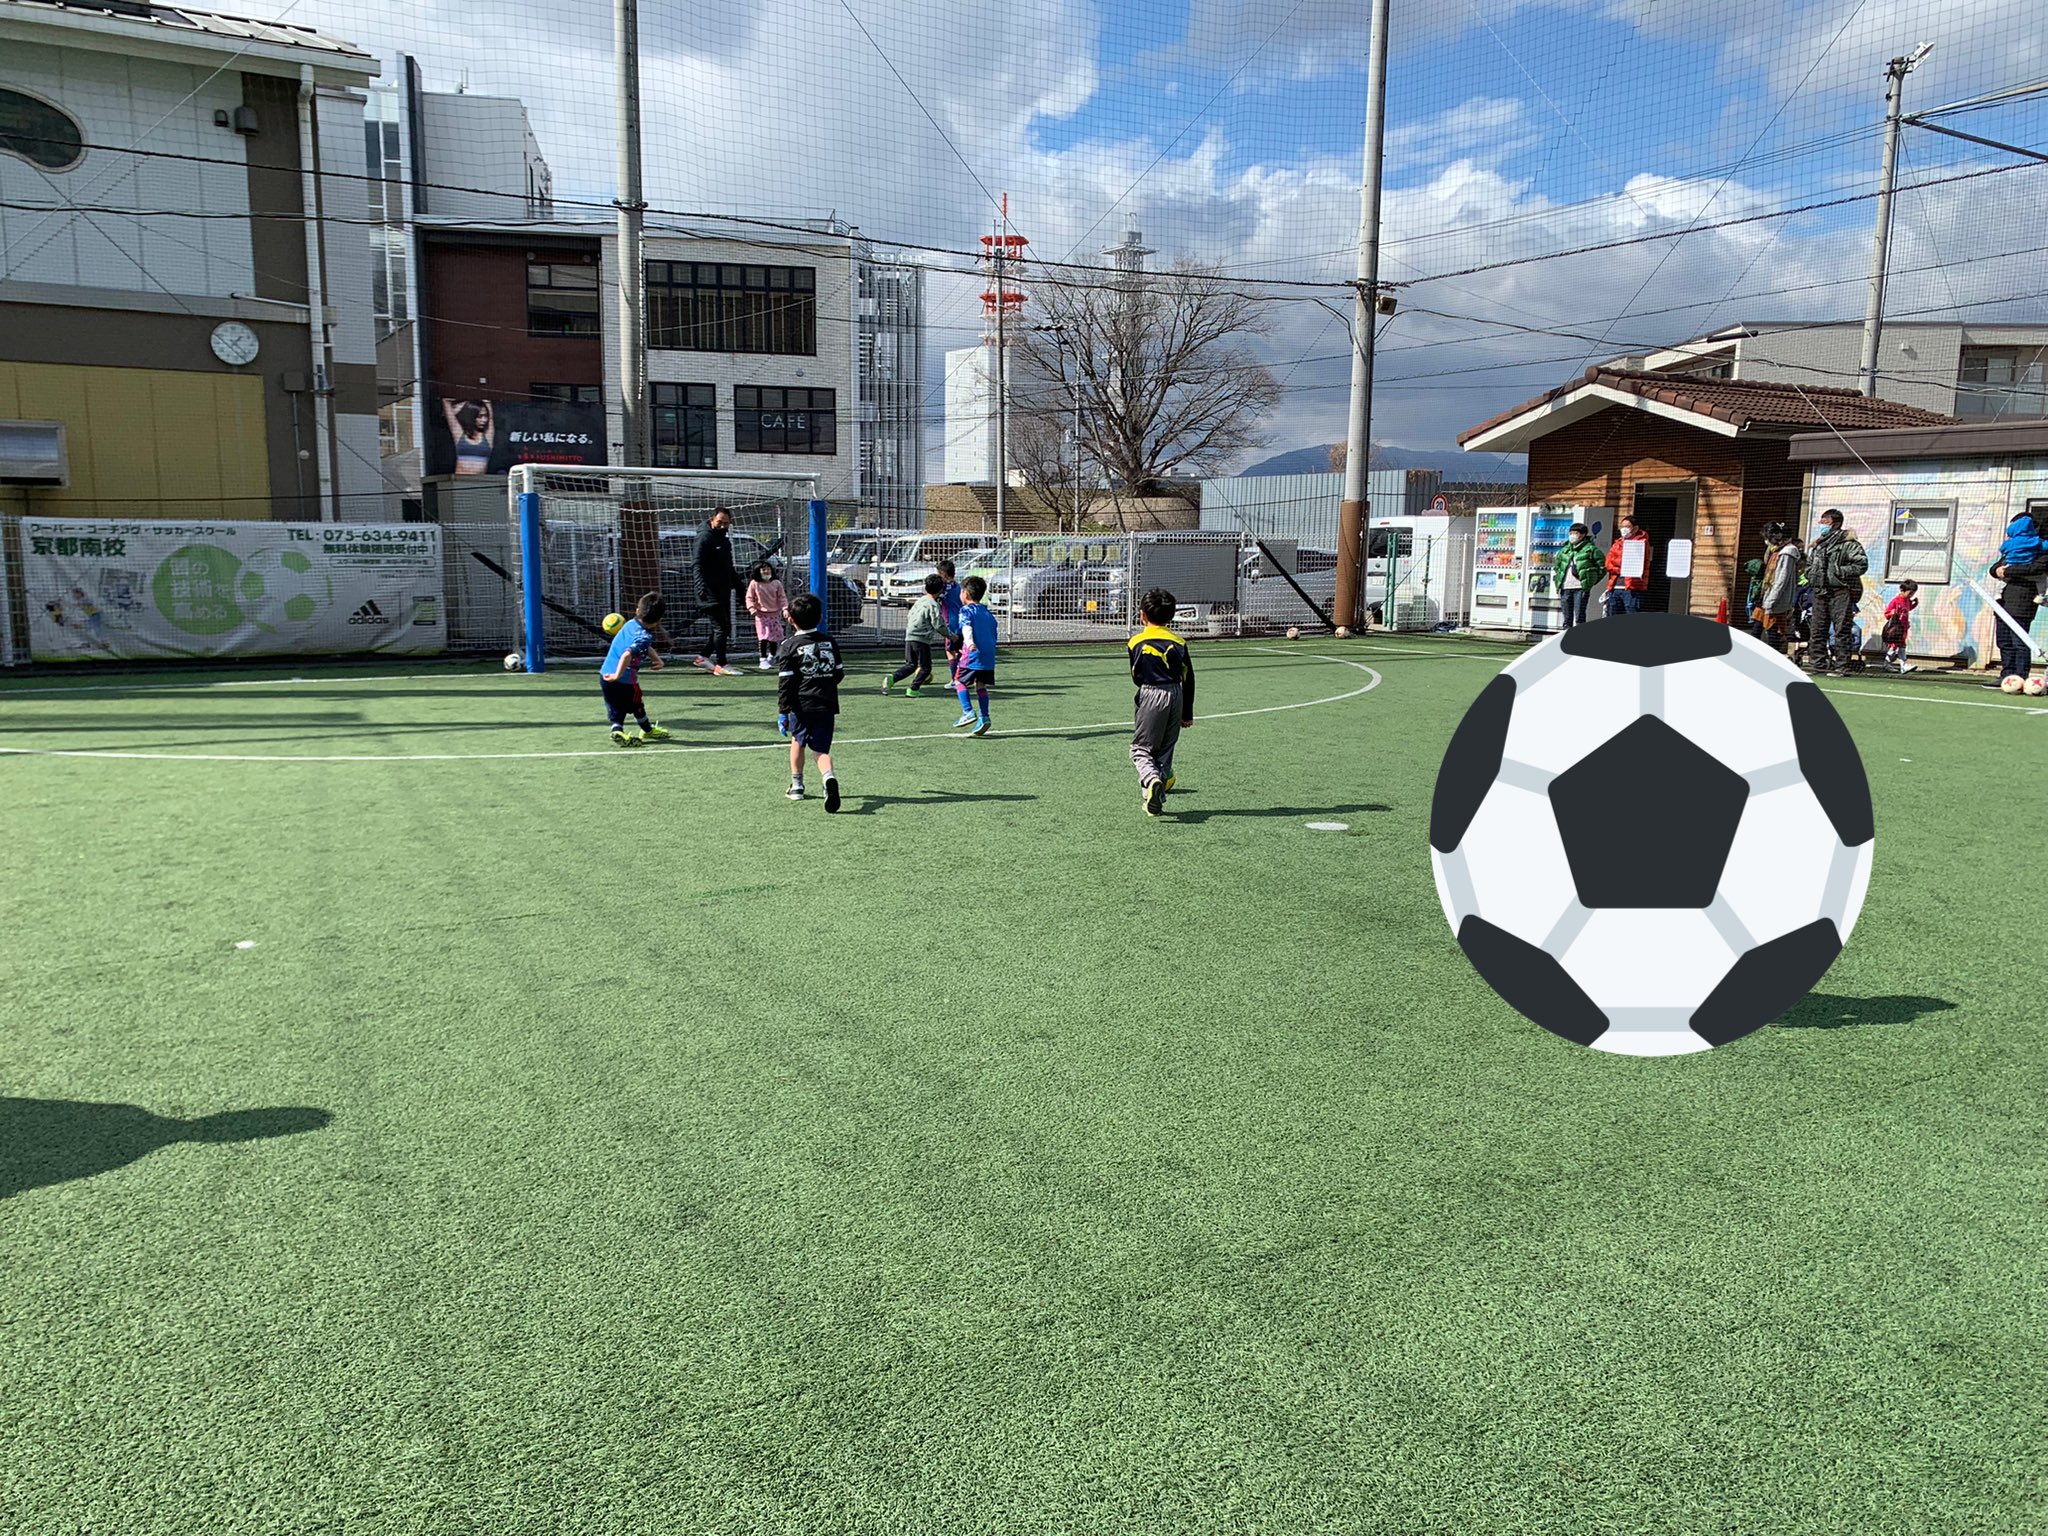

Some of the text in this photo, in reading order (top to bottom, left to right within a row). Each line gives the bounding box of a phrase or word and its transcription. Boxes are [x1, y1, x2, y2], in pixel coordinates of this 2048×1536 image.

[323, 529, 436, 542] 075-634-9411
[30, 537, 126, 557] 京都南校
[348, 615, 389, 625] adidas
